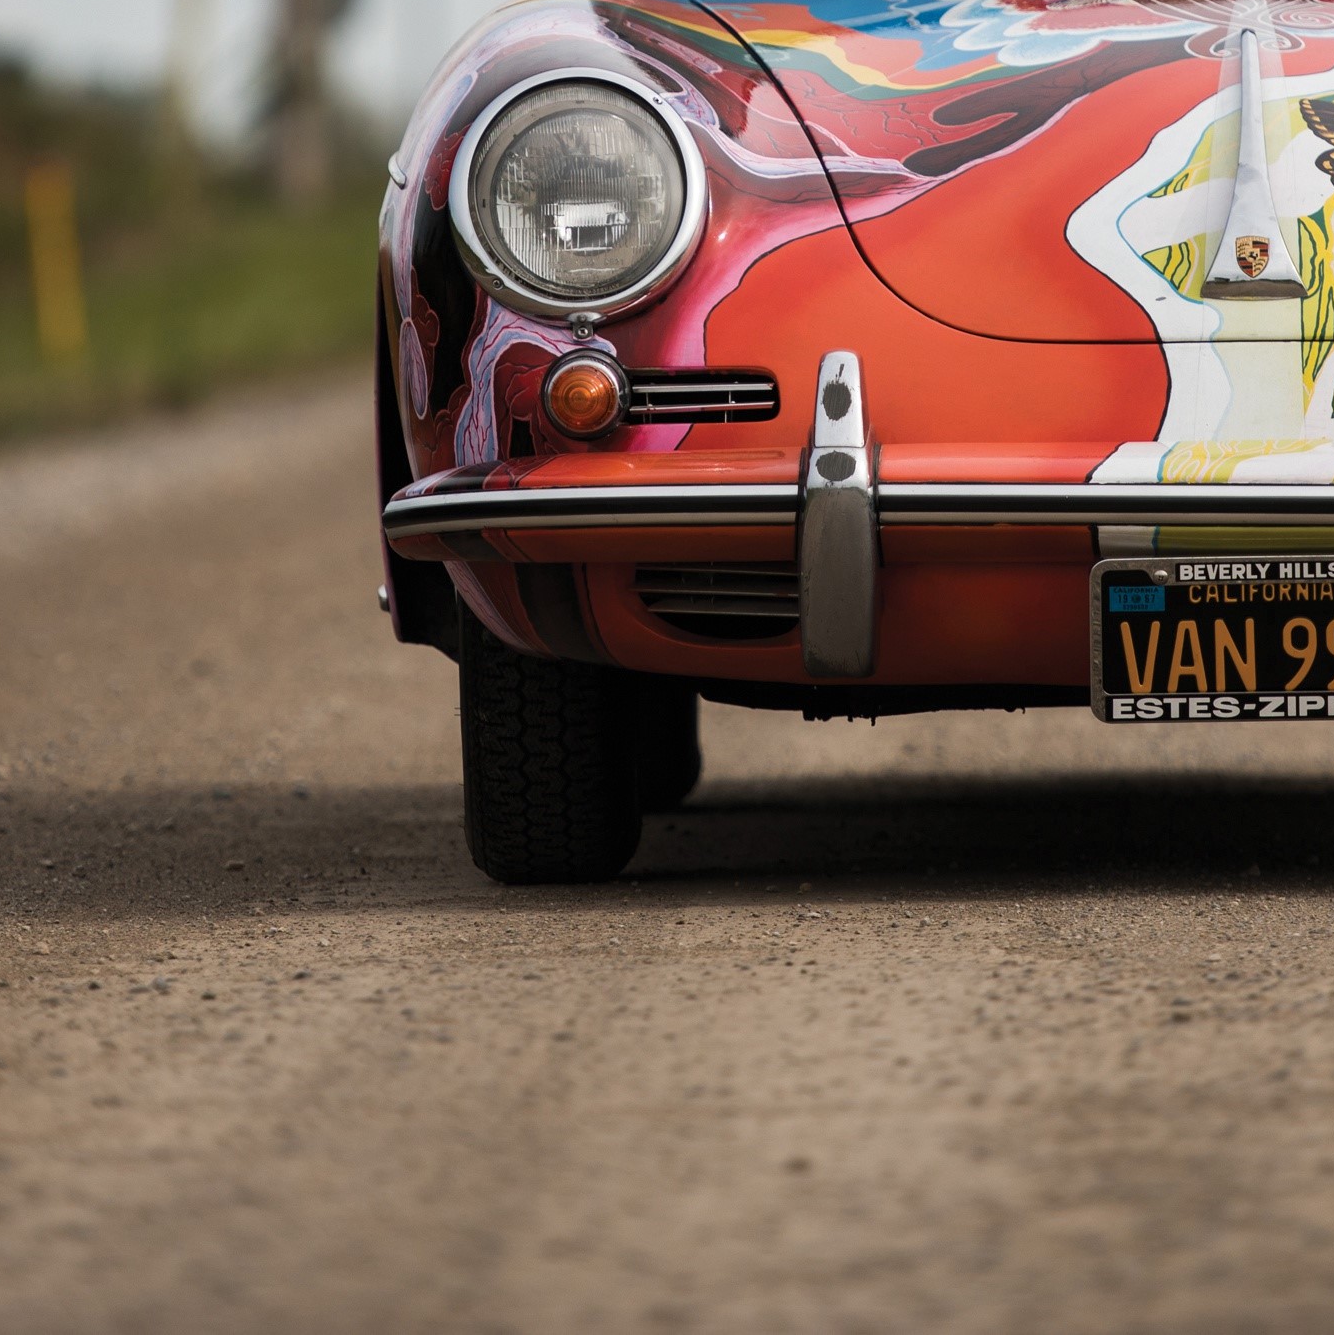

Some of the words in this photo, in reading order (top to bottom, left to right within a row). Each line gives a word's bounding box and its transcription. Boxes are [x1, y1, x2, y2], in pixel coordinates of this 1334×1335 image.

[1179, 563, 1271, 581] BEVERLY
[1189, 583, 1334, 603] CALIFORNIA
[1120, 618, 1257, 693] VAN
